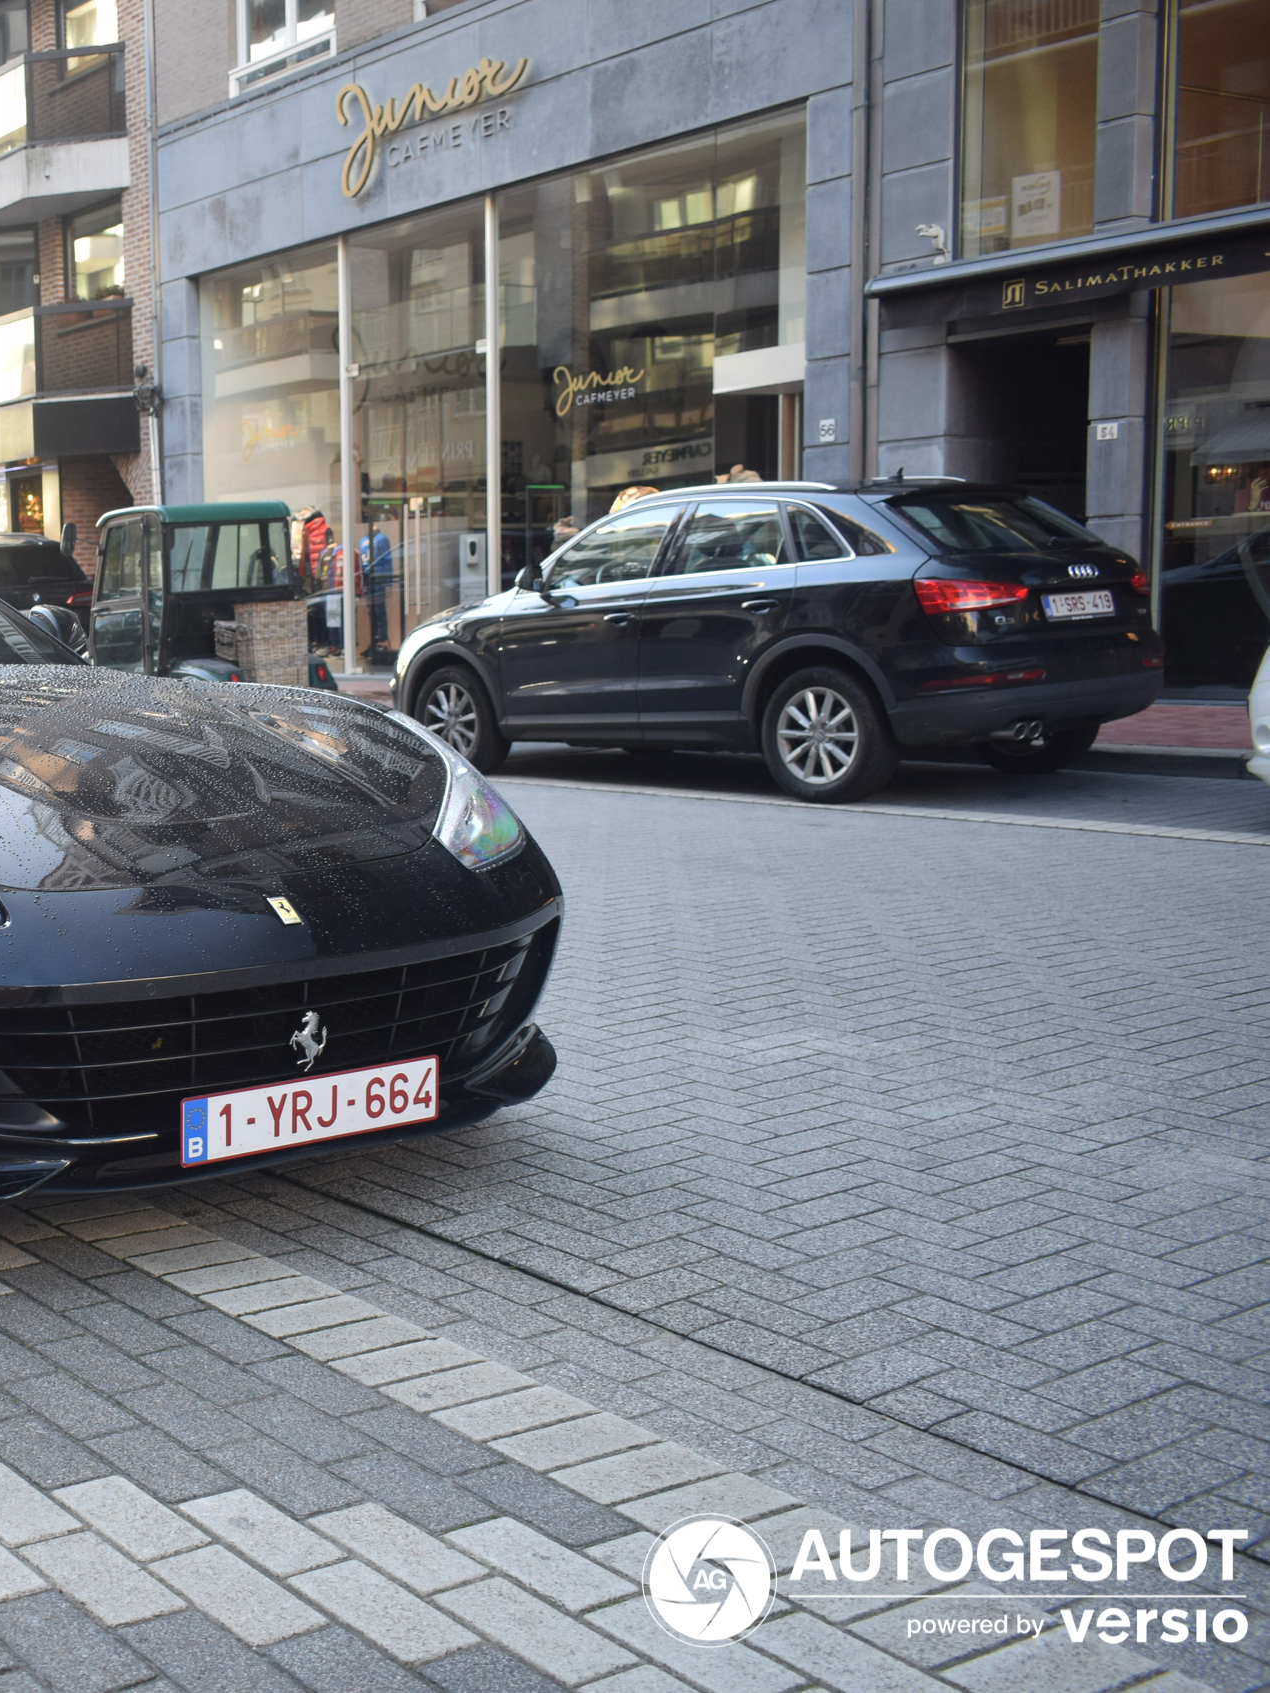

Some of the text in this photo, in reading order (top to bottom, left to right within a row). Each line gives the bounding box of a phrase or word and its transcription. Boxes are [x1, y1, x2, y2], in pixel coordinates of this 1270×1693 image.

[336, 57, 527, 197] Junior
[386, 109, 511, 168] CAFMEYER
[553, 366, 645, 417] Junior
[575, 387, 636, 406] CAFMEYER
[820, 424, 835, 437] 56
[1101, 426, 1114, 438] 54
[1052, 593, 1112, 614] 1-SRS-419
[219, 1067, 433, 1147] 1-YRJ-664
[188, 1137, 203, 1159] B
